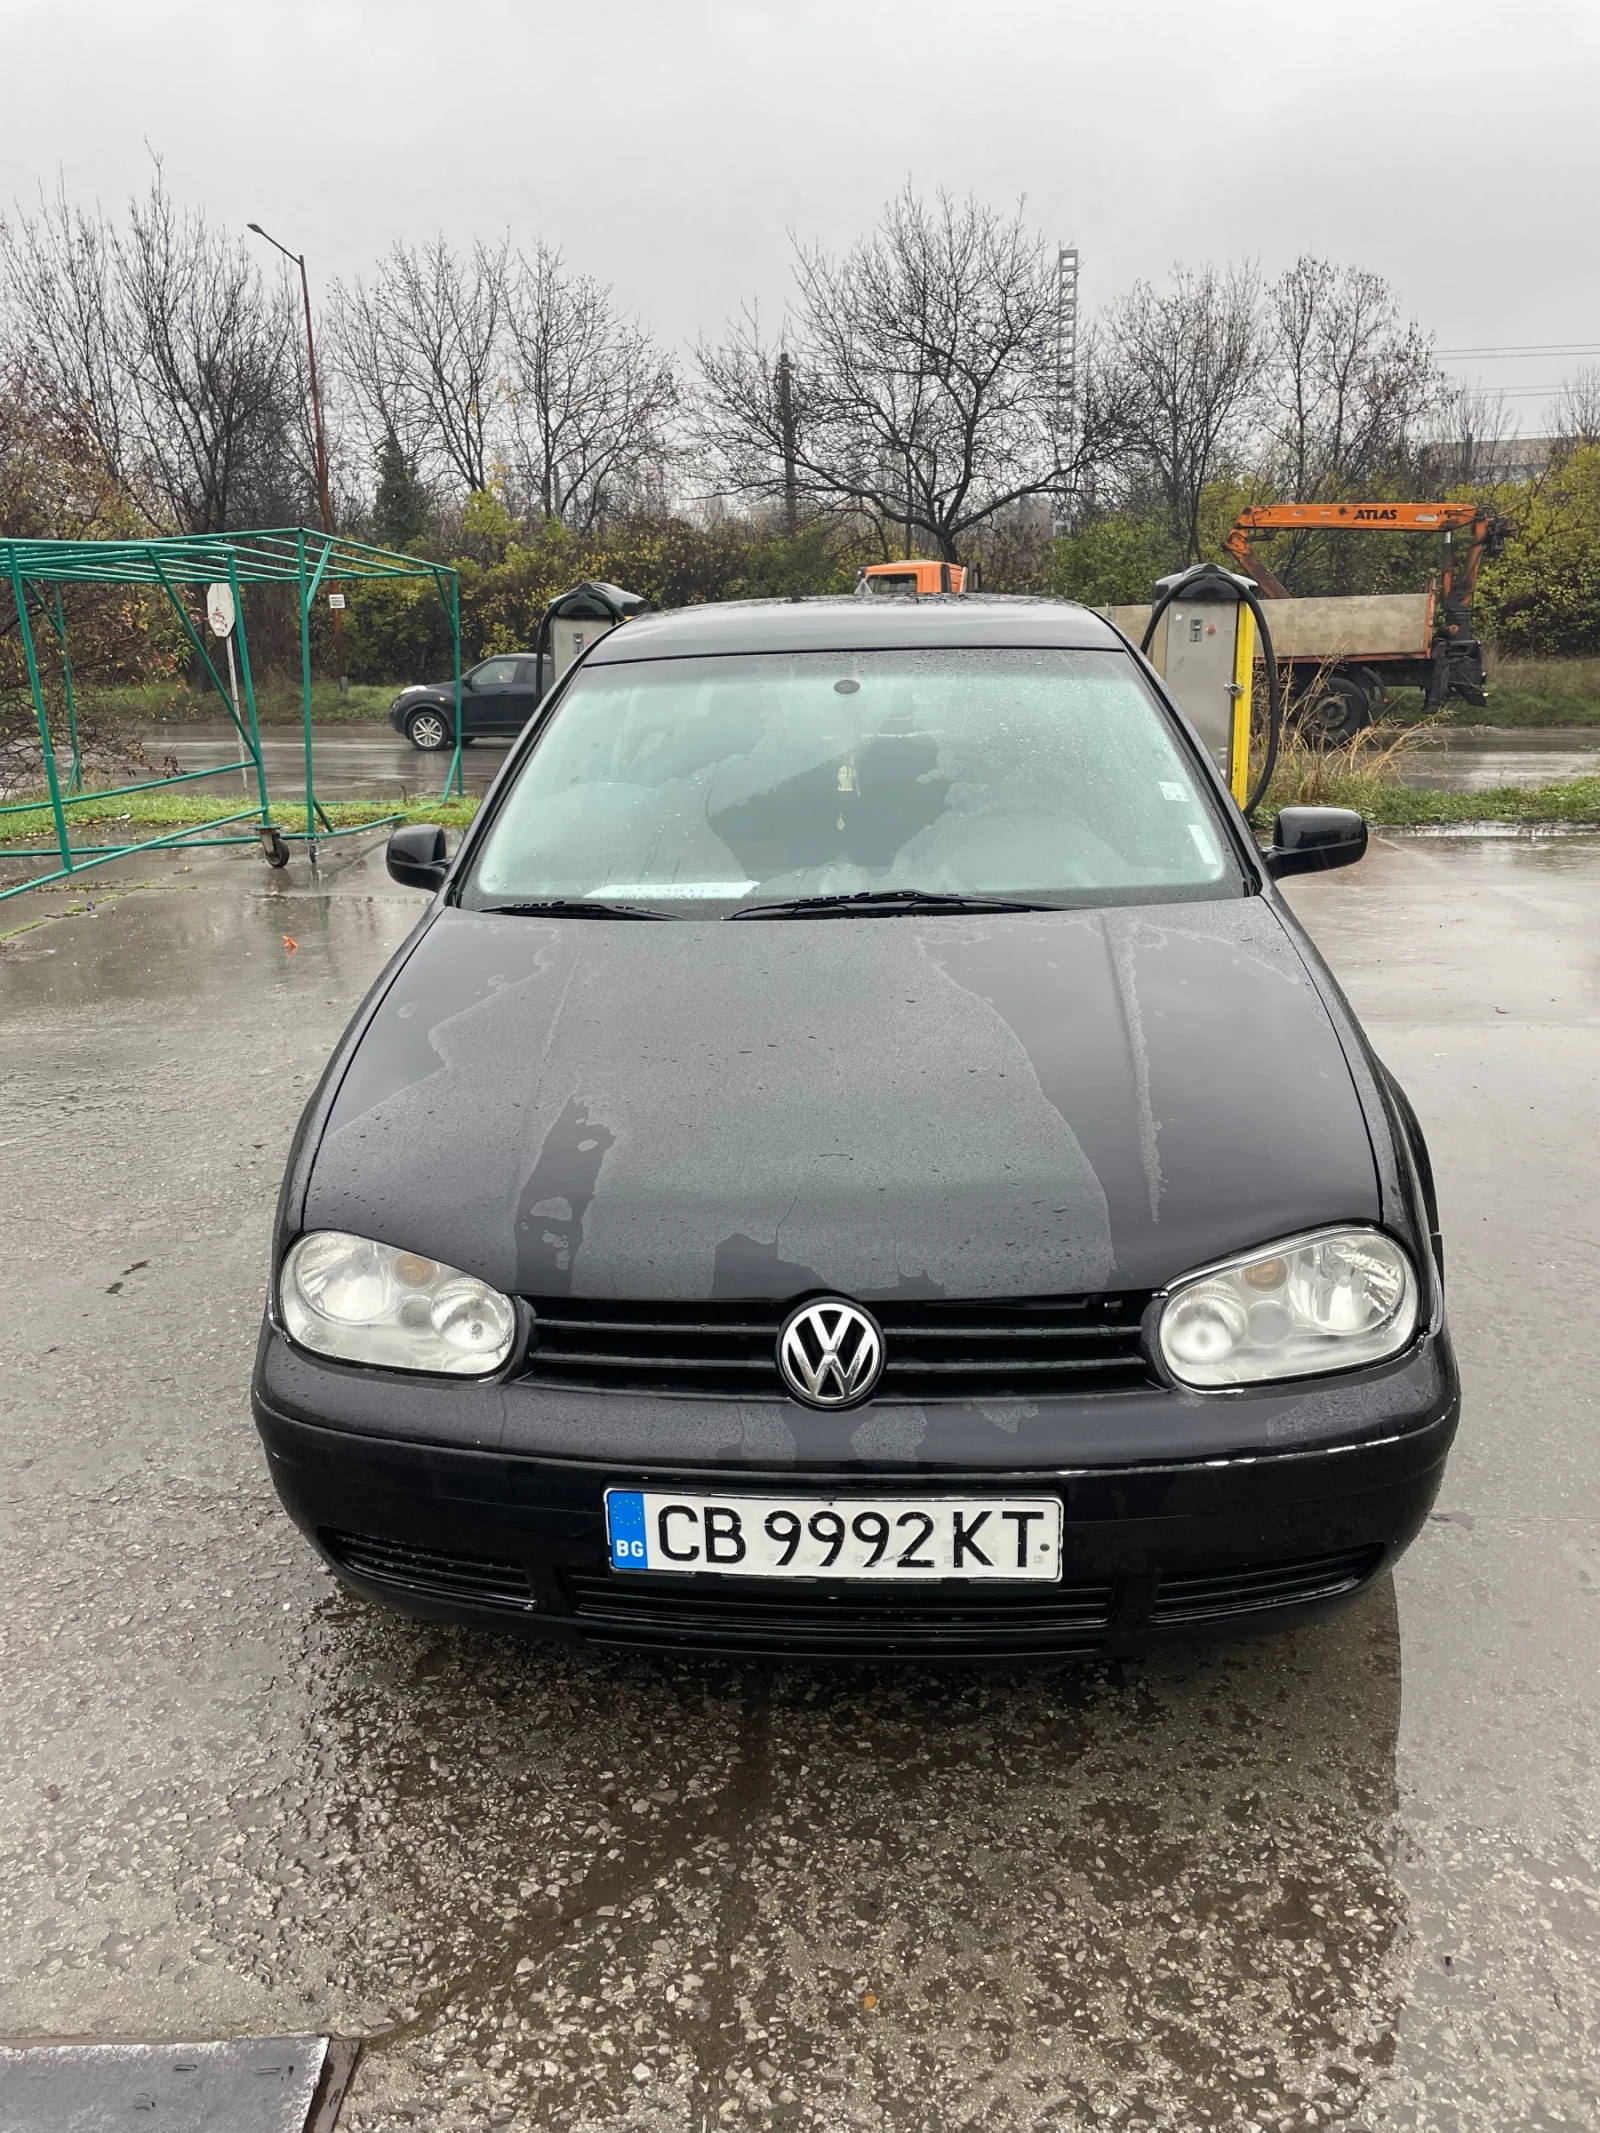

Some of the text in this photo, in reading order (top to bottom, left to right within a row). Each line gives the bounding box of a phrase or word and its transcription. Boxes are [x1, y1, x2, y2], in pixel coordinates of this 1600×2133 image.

[1353, 509, 1398, 520] ATLAS
[657, 1504, 1045, 1568] CB 9992 KT
[615, 1540, 645, 1558] BG
